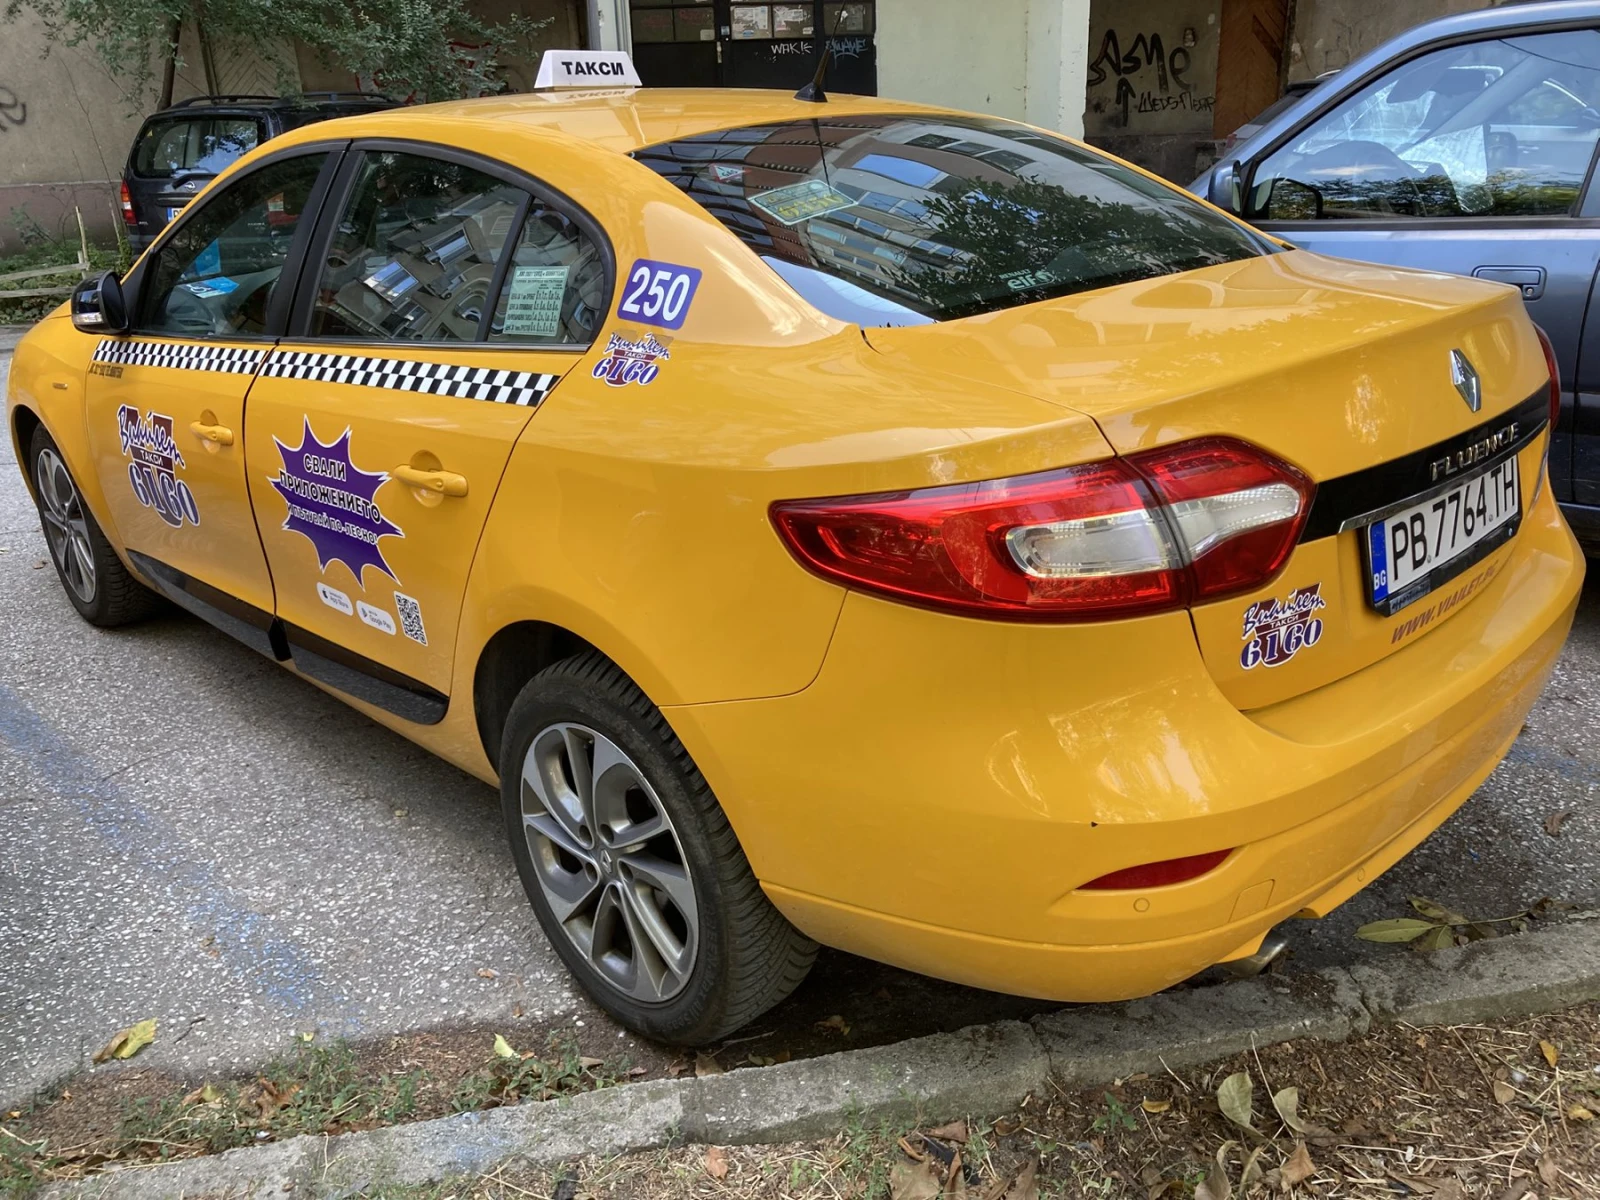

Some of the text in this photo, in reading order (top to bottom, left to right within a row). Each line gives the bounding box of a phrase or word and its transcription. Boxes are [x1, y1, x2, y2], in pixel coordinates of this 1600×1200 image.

[561, 61, 625, 76] ТАКСИ
[622, 266, 691, 322] 250
[592, 358, 659, 385] 6160
[140, 449, 164, 467] ТАКСИ
[1430, 422, 1519, 482] FLUENCE
[303, 453, 347, 482] СВАЛИ
[128, 462, 200, 526] 6160
[279, 468, 382, 525] ПРИЛОЖЕНИЕТО
[1373, 569, 1387, 591] BG
[1270, 614, 1299, 629] ТАКСИ
[1240, 618, 1323, 669] 6160
